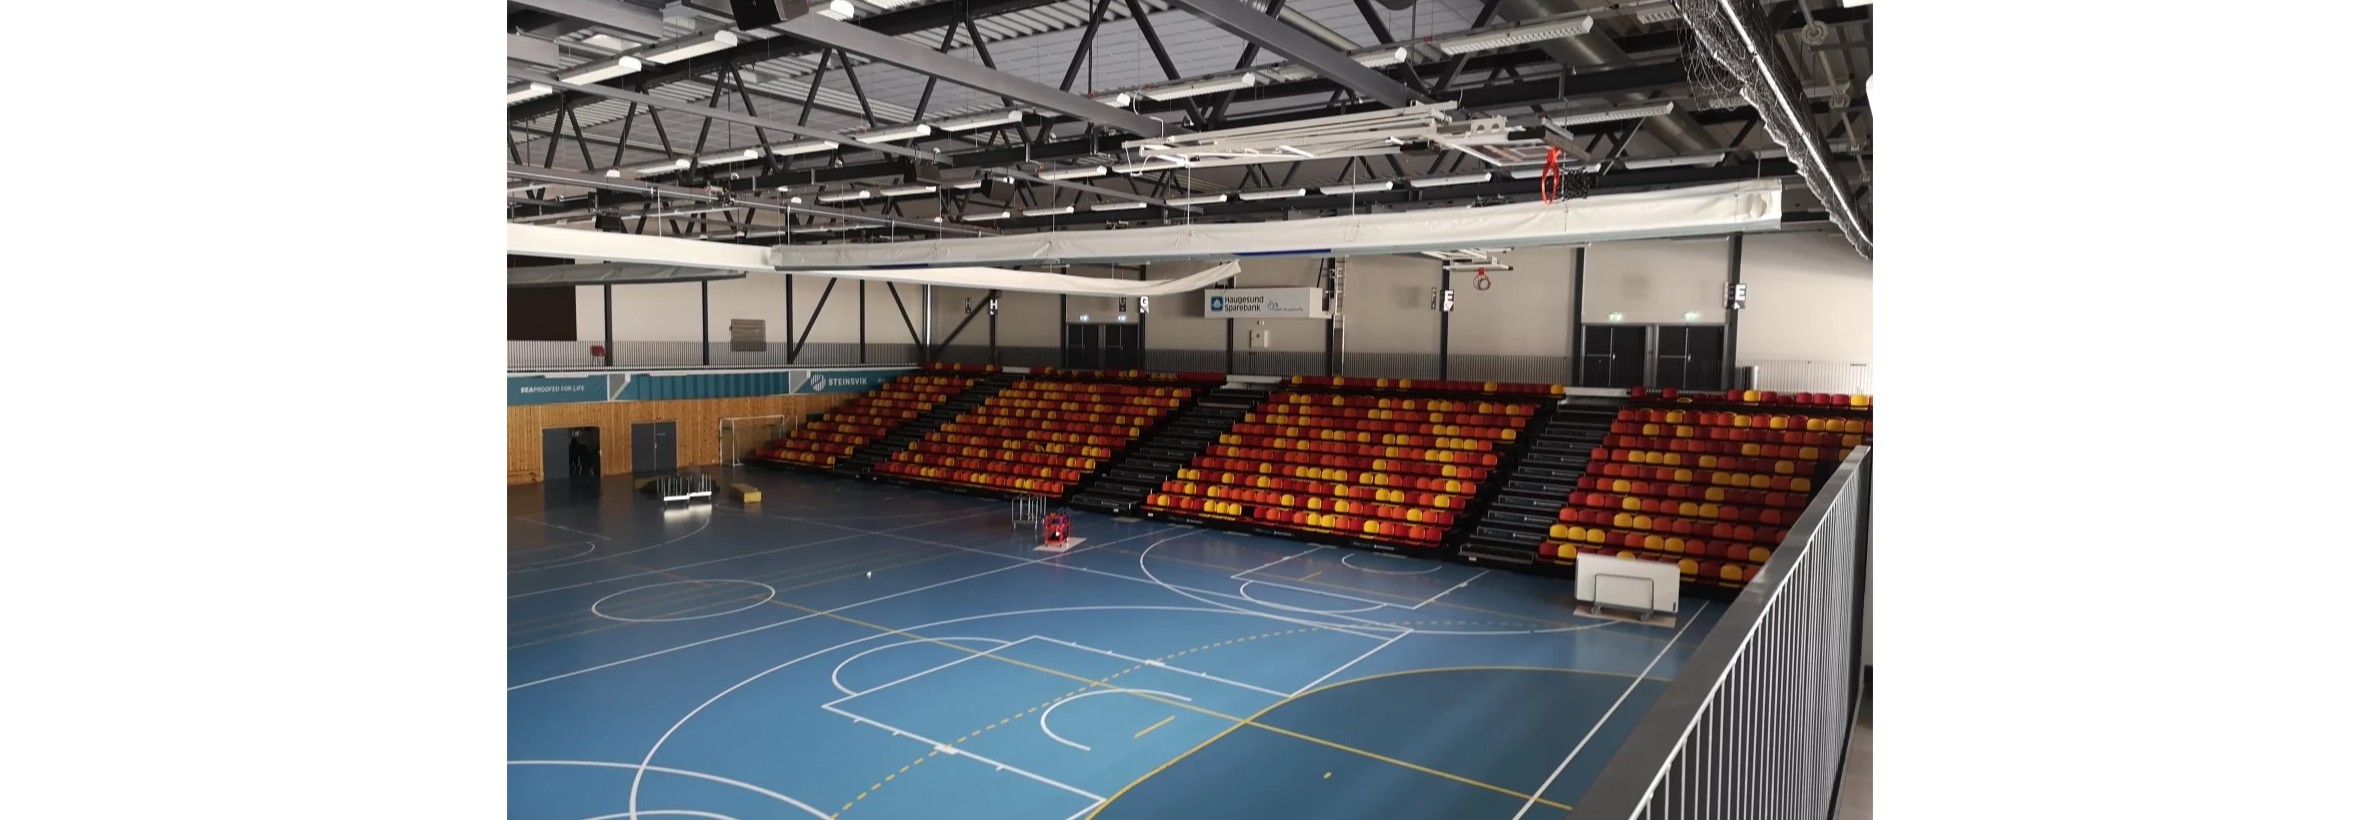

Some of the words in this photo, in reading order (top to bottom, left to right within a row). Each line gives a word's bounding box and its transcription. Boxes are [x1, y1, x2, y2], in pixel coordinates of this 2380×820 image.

[1735, 284, 1746, 301] E
[1140, 296, 1149, 307] G
[1224, 295, 1264, 304] Haugesund
[989, 299, 998, 310] H
[1224, 304, 1261, 313] Sparebank
[828, 377, 867, 386] STEINSVIK
[573, 384, 585, 392] LIFE
